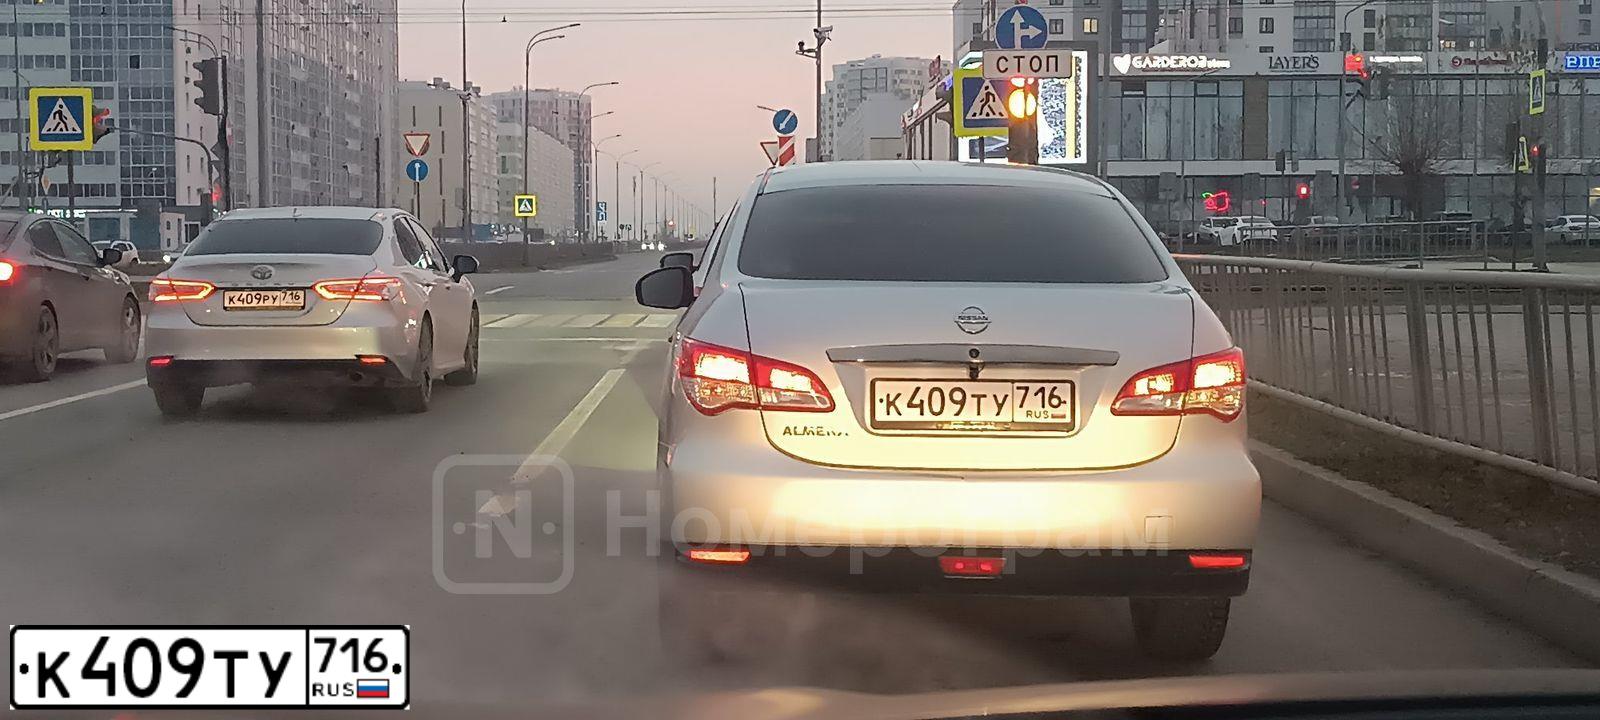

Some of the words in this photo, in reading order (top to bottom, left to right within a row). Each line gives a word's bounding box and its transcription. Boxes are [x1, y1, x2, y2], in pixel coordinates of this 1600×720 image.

[996, 55, 1058, 73] СТОП
[228, 292, 279, 305] К409РУ
[281, 291, 300, 301] 716
[886, 386, 1009, 416] К409ТУ
[1016, 386, 1062, 409] 716
[1026, 410, 1050, 419] RUS
[782, 426, 849, 437] ALME
